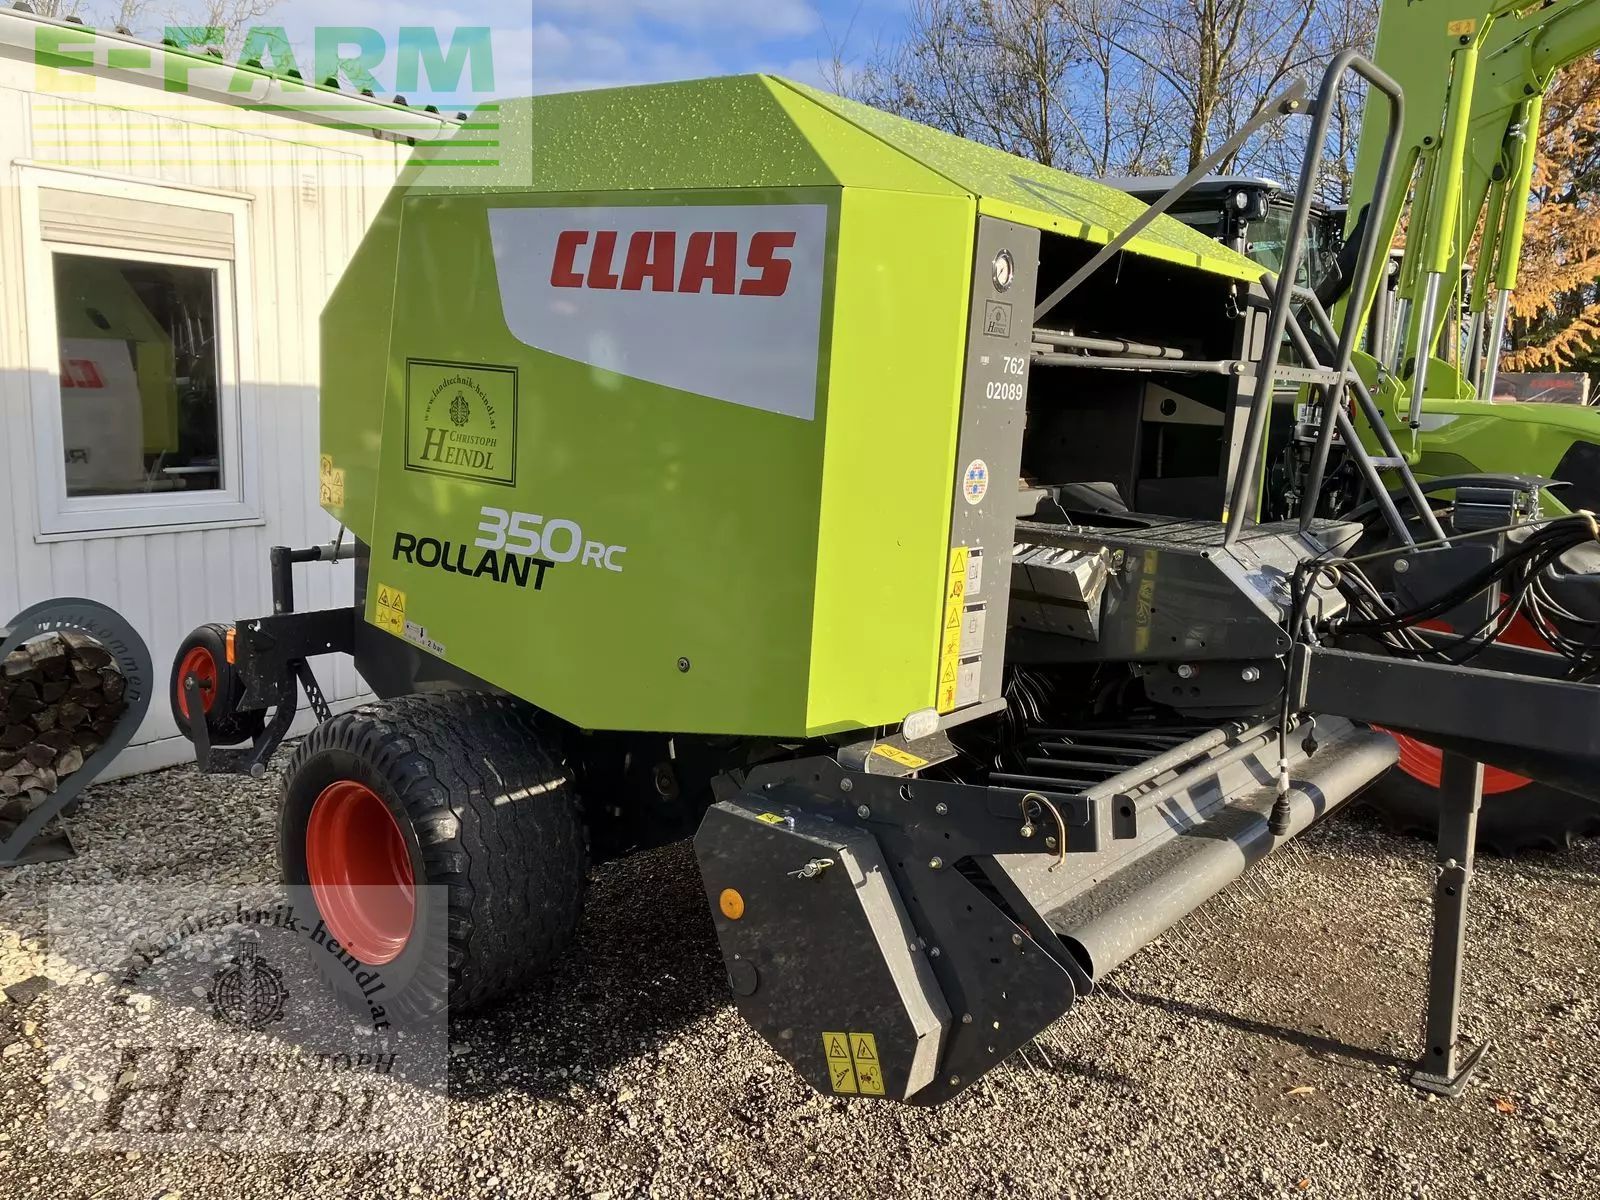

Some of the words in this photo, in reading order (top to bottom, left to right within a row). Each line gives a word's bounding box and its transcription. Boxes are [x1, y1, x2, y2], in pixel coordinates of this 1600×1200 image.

[550, 230, 797, 297] CLAAS
[986, 381, 1023, 400] 02089
[1003, 356, 1025, 375] 762
[424, 374, 497, 430] www.landtechnik-heindl.at
[392, 532, 555, 591] ROLLANT
